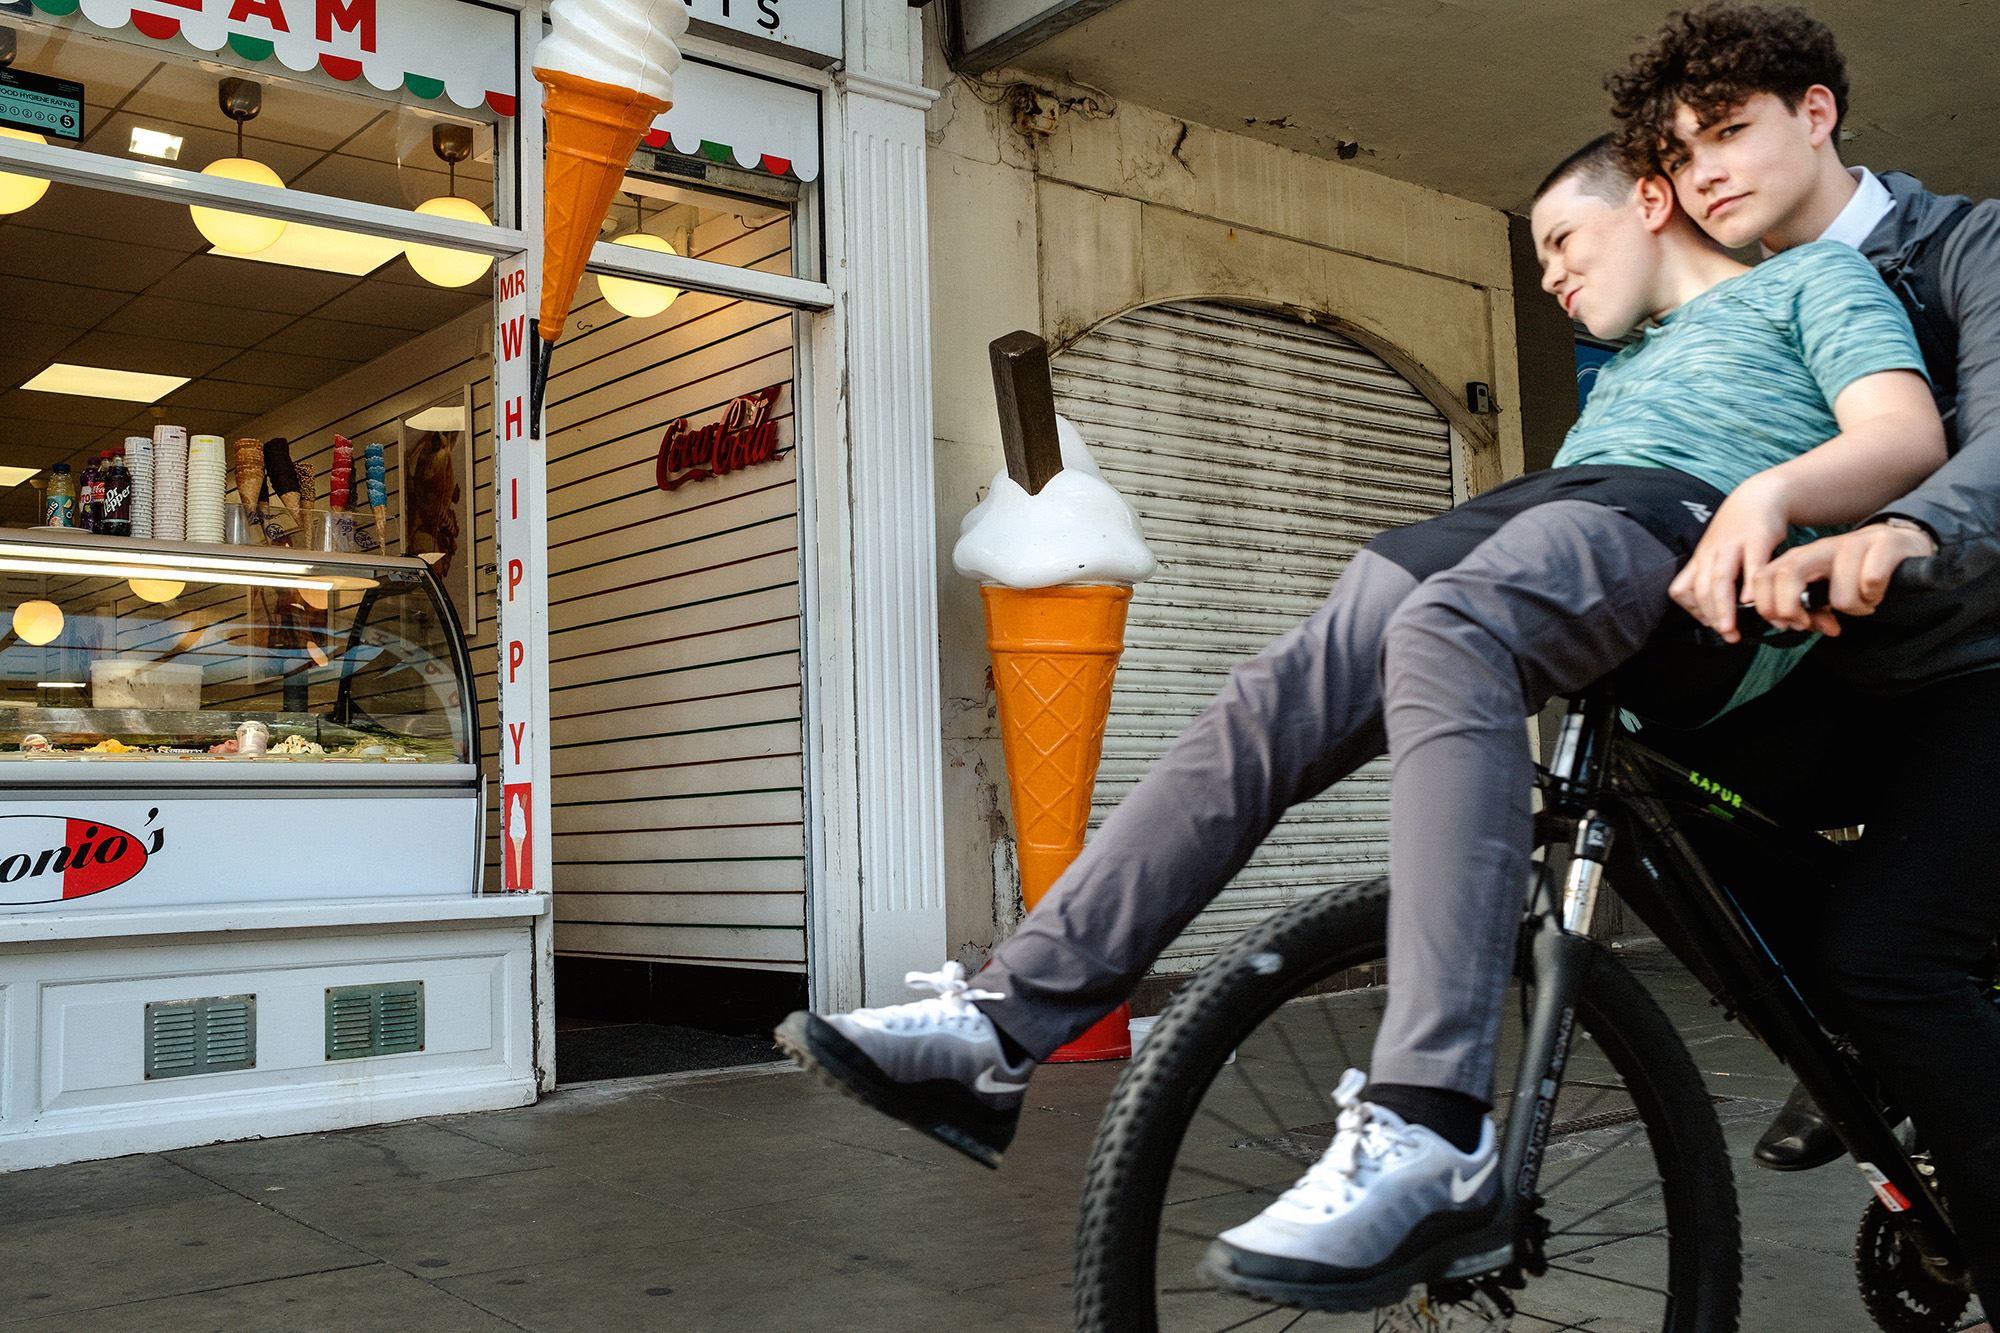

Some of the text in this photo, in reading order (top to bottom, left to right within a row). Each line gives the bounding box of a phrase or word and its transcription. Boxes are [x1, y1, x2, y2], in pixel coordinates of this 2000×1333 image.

[0, 87, 76, 109] OOD HYGIENE RATING
[500, 269, 526, 303] MR
[104, 486, 130, 517] Pepper
[106, 487, 118, 501] Dr
[501, 314, 526, 765] WHIPPY
[1689, 770, 1742, 808] KAPUR
[0, 807, 164, 883] onio's
